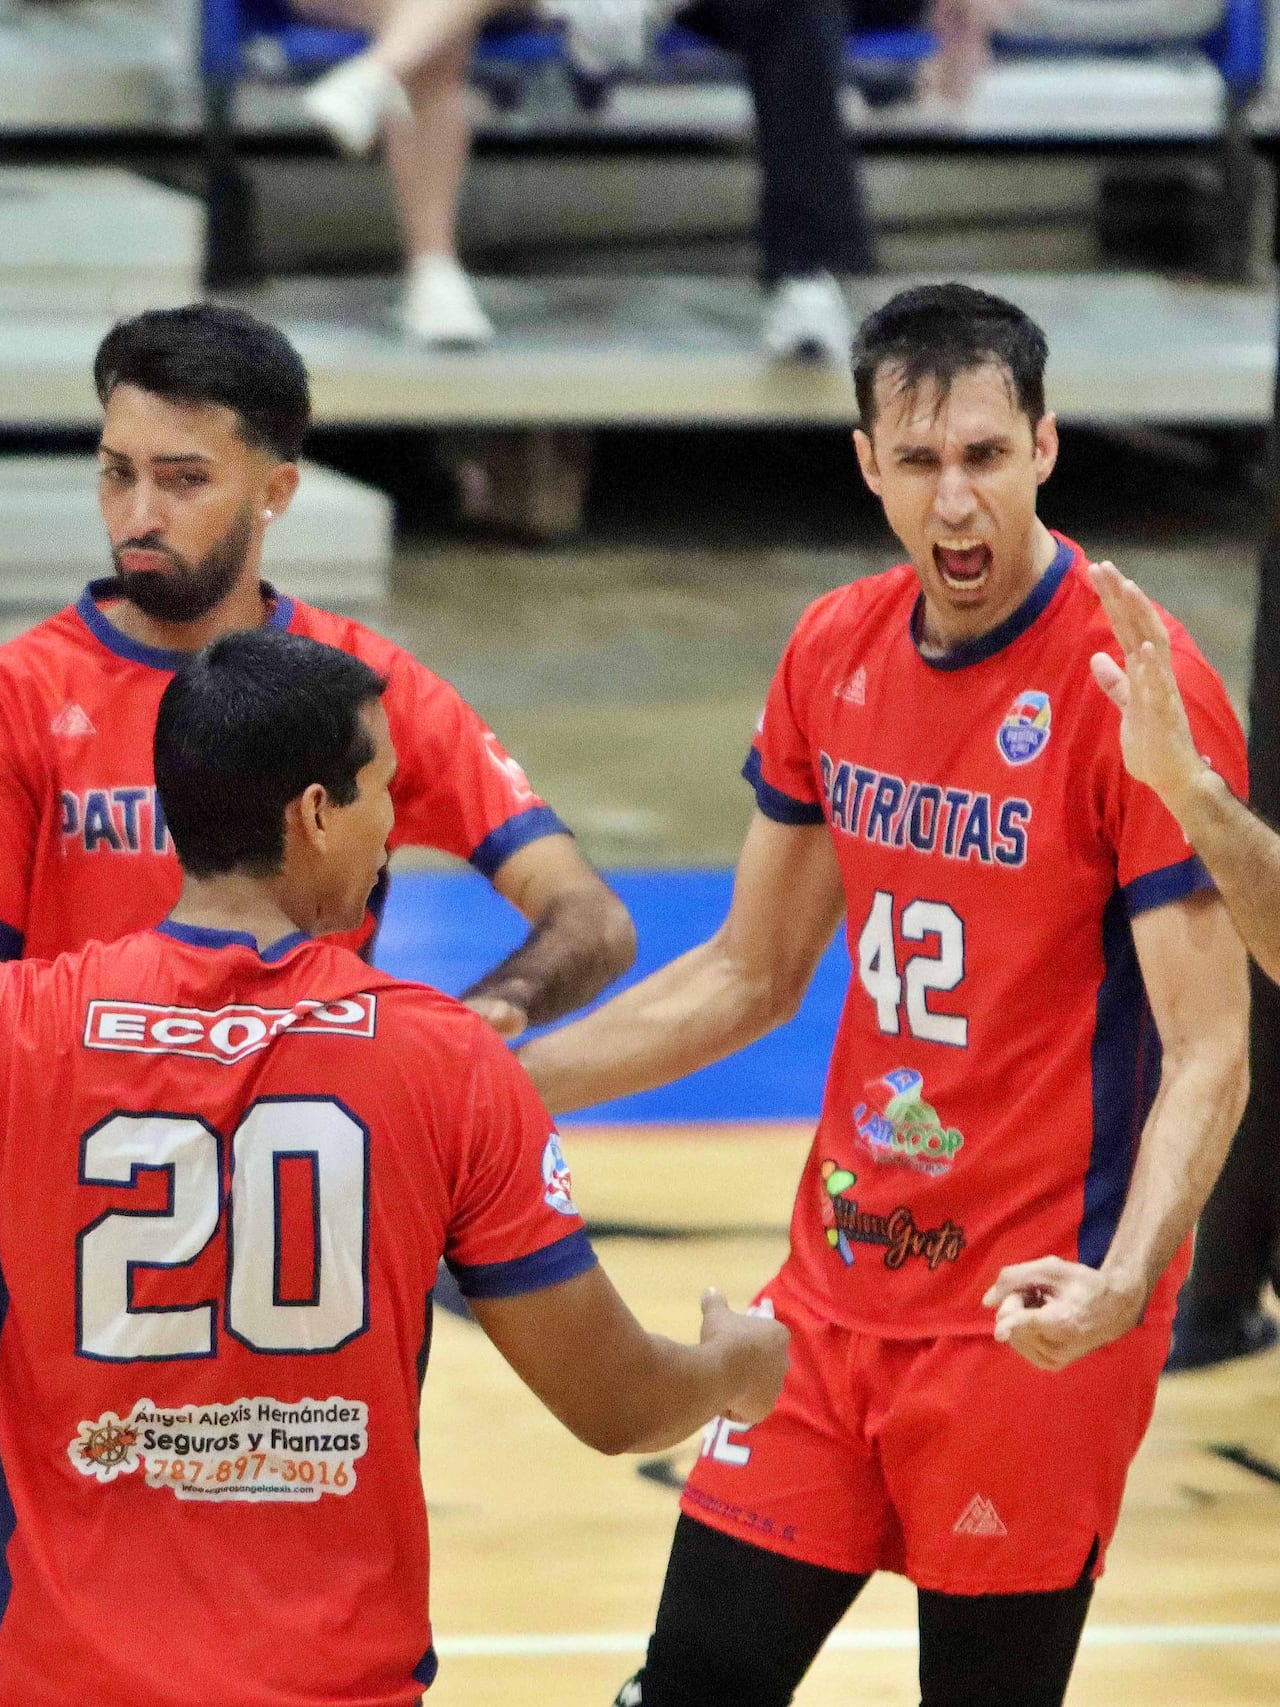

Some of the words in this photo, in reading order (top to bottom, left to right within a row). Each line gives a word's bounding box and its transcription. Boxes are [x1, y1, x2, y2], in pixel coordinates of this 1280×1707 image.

[820, 749, 1032, 869] PATRIOTAS
[858, 887, 969, 1048] 42
[98, 1000, 366, 1055] ECOO
[74, 1094, 370, 1363] 20
[143, 1429, 240, 1455] Seguros
[248, 1433, 263, 1452] y
[271, 1428, 361, 1452] Fianzas
[199, 1404, 252, 1426] Alexis
[258, 1403, 361, 1424] Hernández
